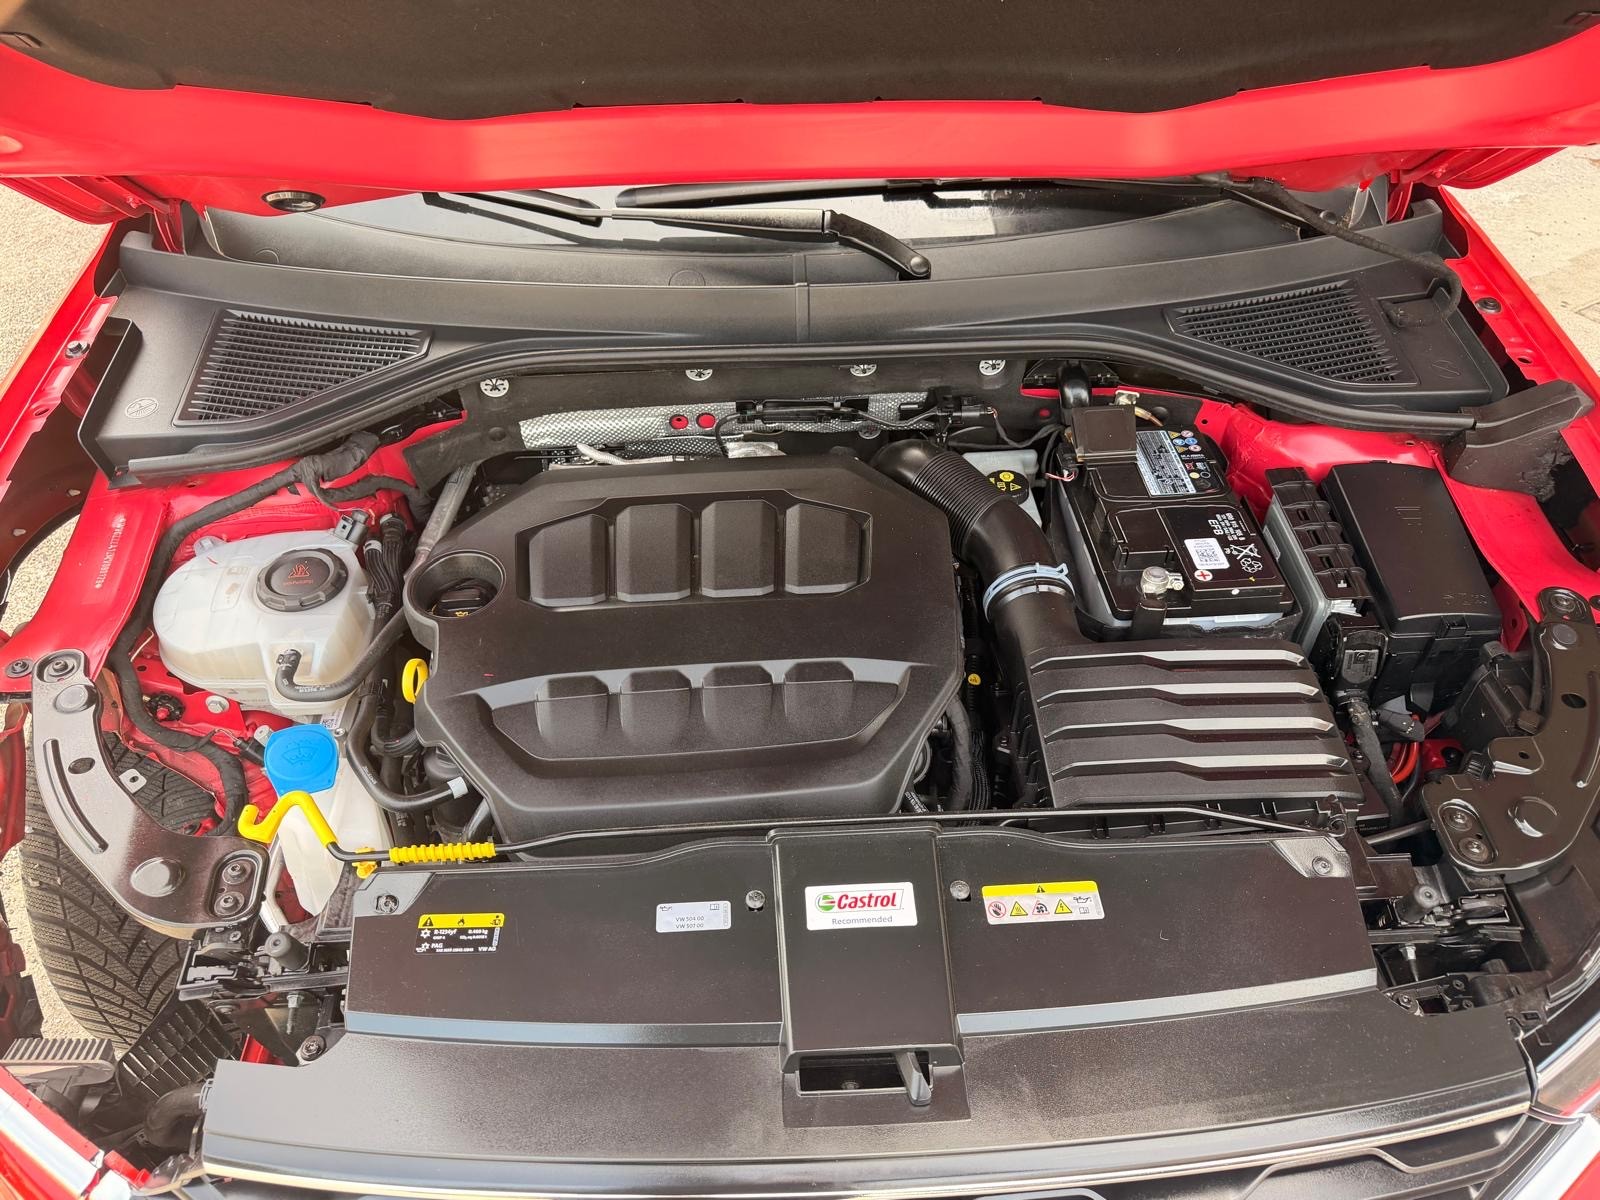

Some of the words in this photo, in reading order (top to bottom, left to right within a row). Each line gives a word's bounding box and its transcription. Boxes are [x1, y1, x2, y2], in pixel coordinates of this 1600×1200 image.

[1208, 520, 1223, 535] EFB
[837, 892, 897, 910] Castrol
[832, 915, 893, 925] Recommended
